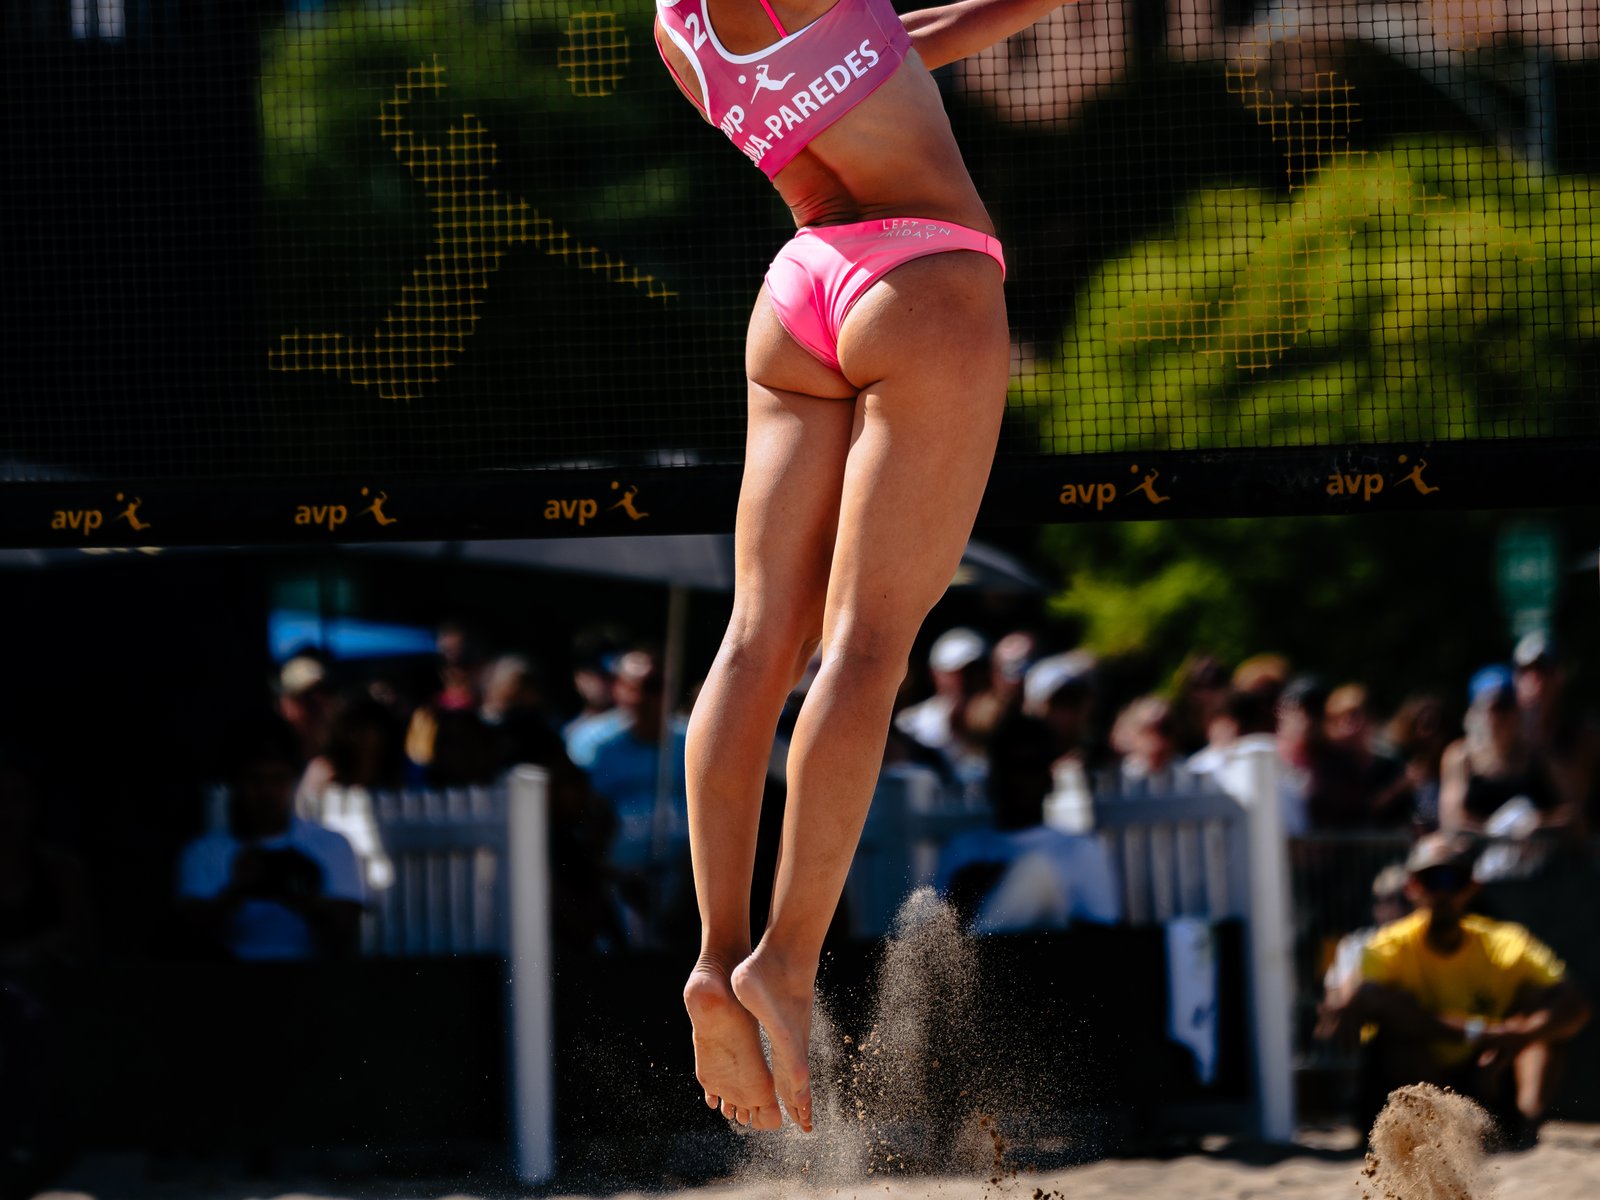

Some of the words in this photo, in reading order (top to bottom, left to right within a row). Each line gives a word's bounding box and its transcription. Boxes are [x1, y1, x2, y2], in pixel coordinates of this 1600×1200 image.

[684, 12, 708, 51] 2
[1059, 482, 1116, 511] avp
[1327, 472, 1384, 501] avp
[51, 510, 103, 535] avp
[294, 504, 348, 531] avp
[544, 498, 598, 526] avp
